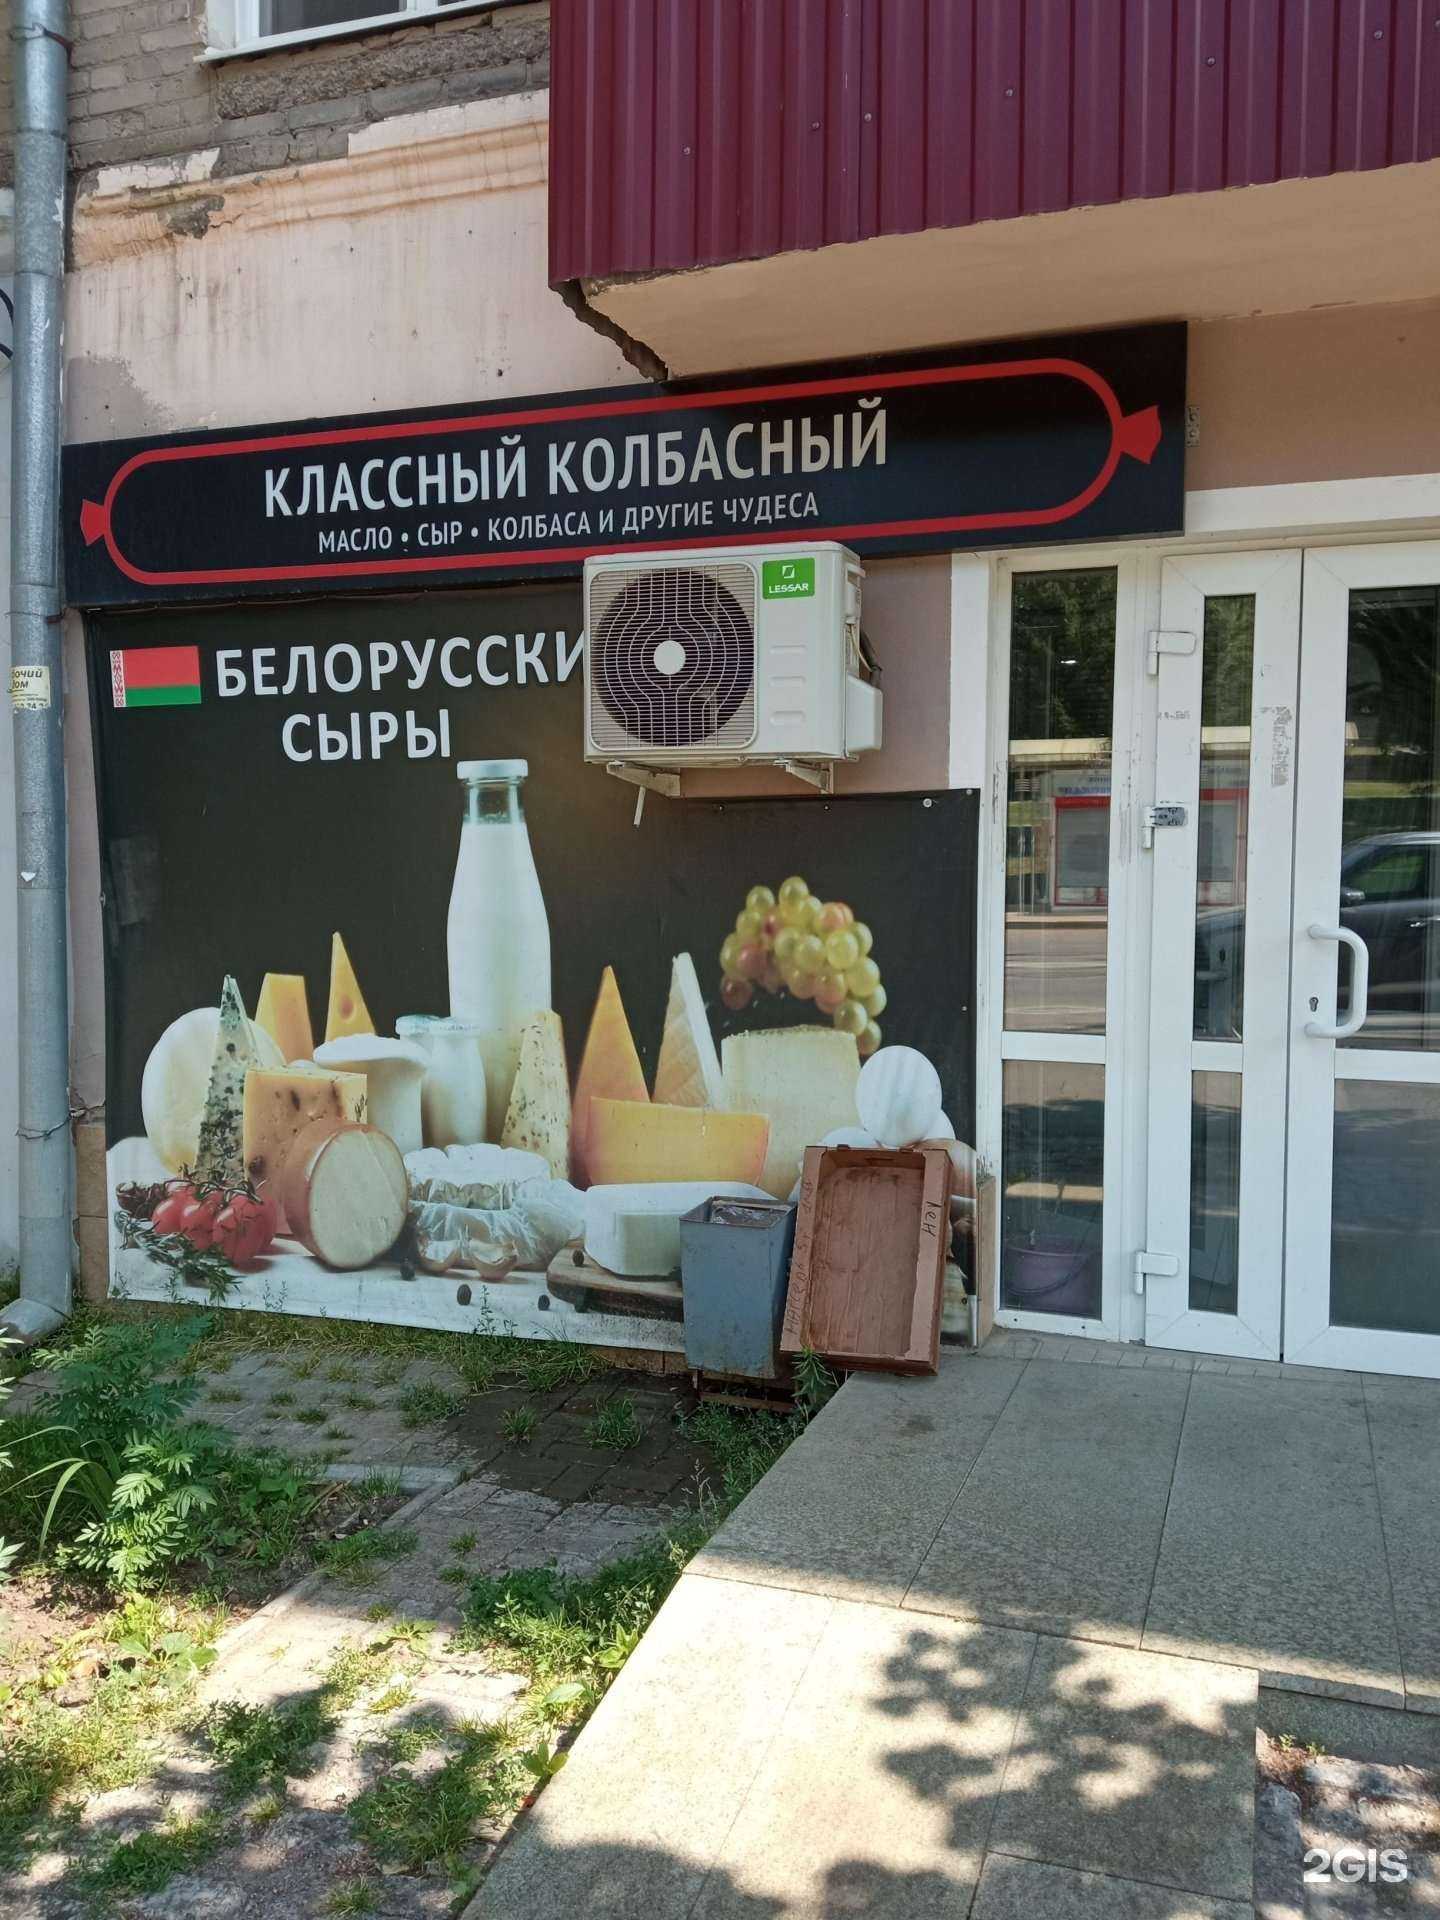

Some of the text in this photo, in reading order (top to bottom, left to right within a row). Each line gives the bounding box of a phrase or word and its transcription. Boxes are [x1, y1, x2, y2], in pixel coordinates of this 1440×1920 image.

[265, 397, 886, 518] КЛАССНЫЙ КОЛБАСНЫЙ
[318, 492, 819, 554] МАСЛО СЫР КОЛБАСА И ДРУГИЕ ЧУДЕСА
[768, 582, 809, 594] LESSAR
[215, 630, 584, 697] БЕЛОРУССКИ
[282, 709, 451, 762] СЫРЫ
